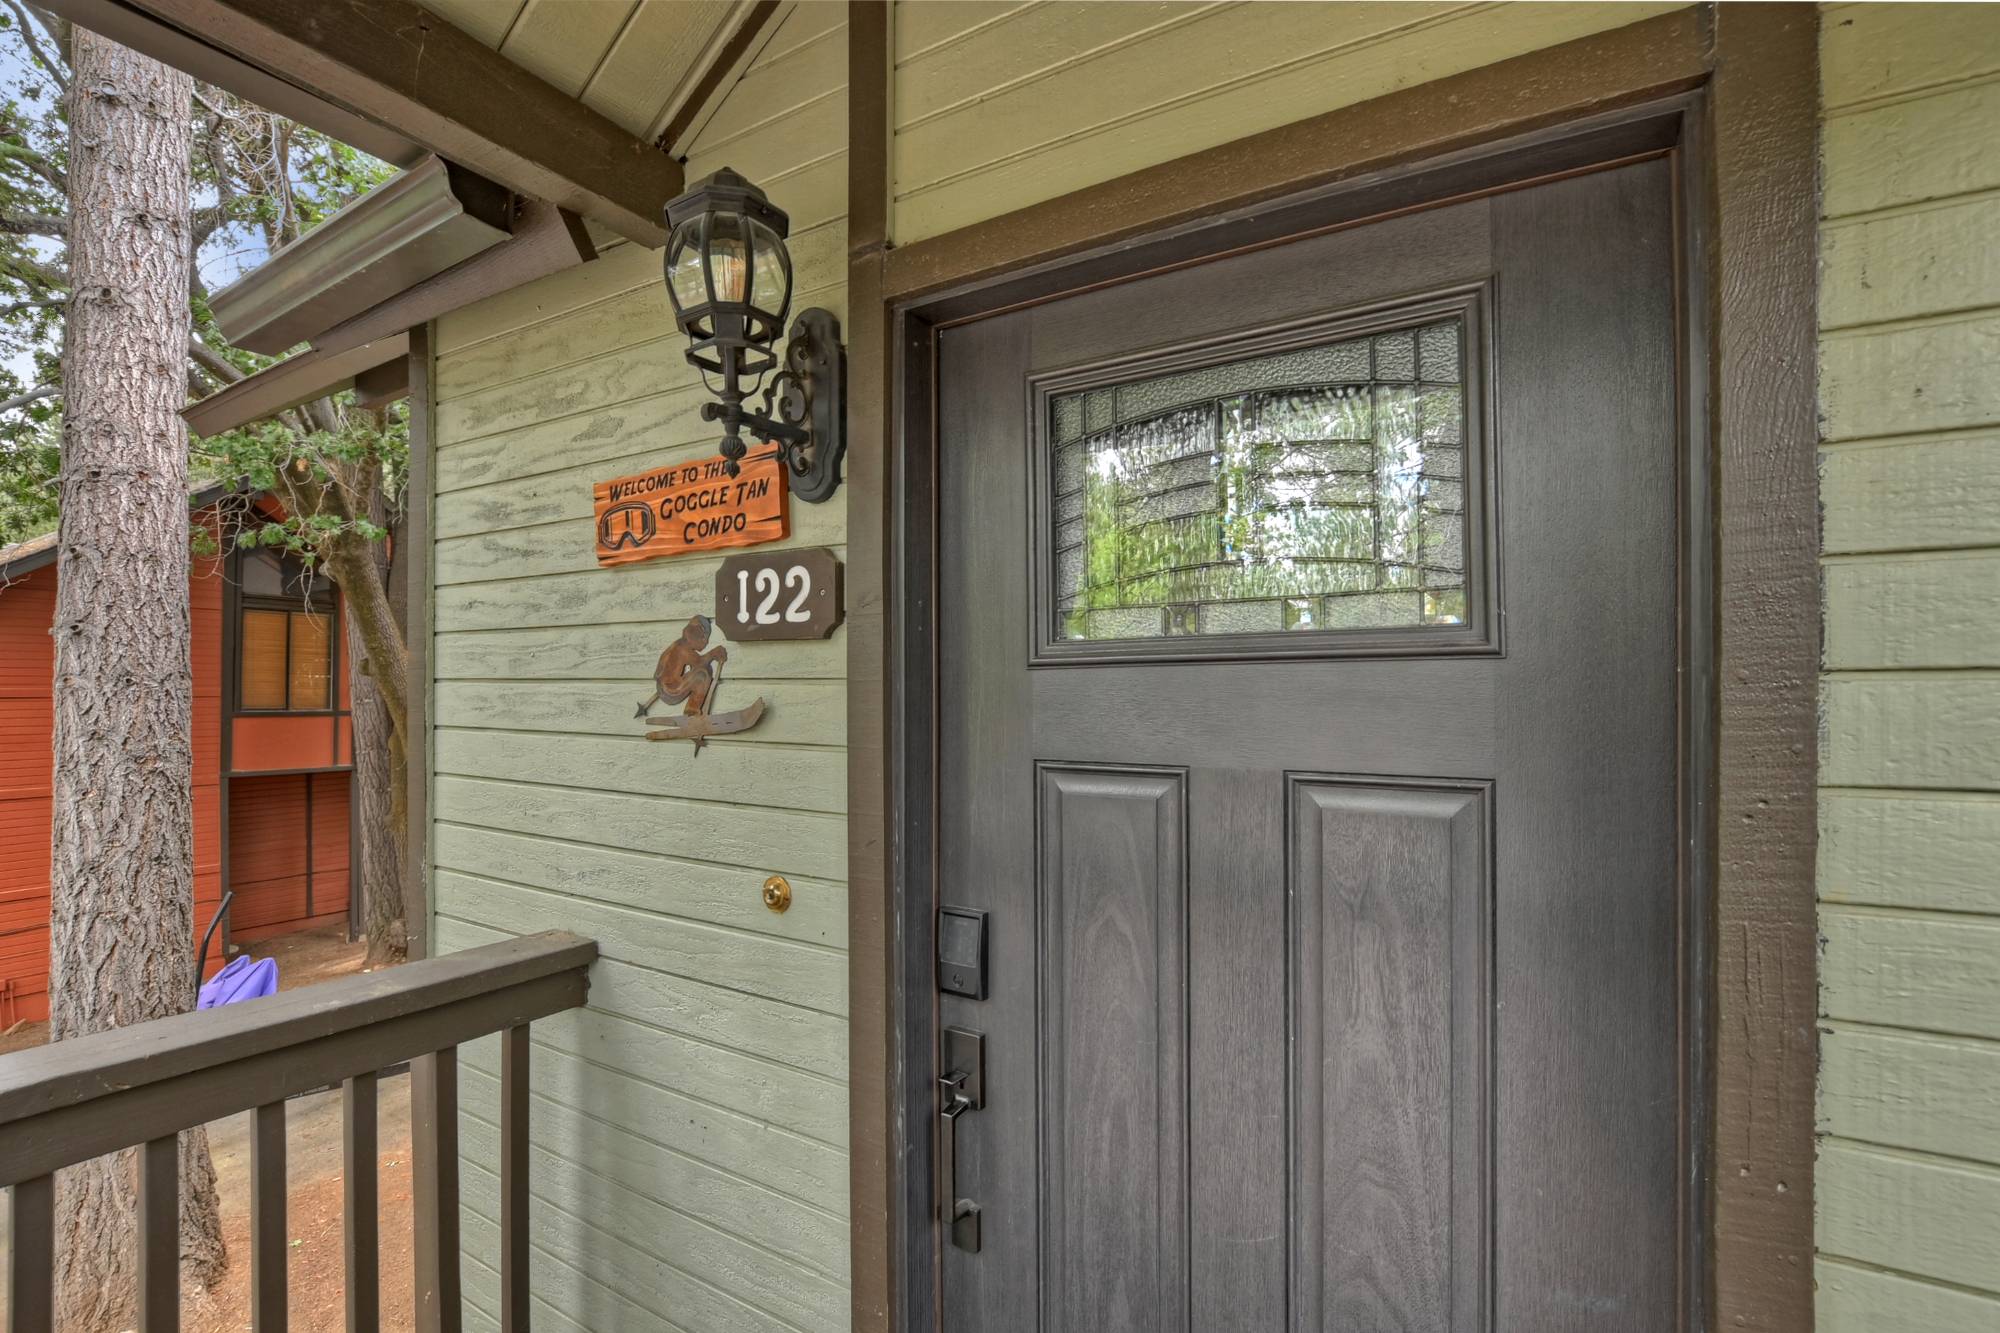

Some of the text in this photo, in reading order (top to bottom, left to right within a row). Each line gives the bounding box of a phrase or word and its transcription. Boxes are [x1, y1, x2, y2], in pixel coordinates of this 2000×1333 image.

[609, 460, 730, 503] WELCOME TO THE
[660, 477, 770, 520] GOGGLE TAN
[683, 512, 747, 545] CONDO
[737, 565, 811, 624] 122
